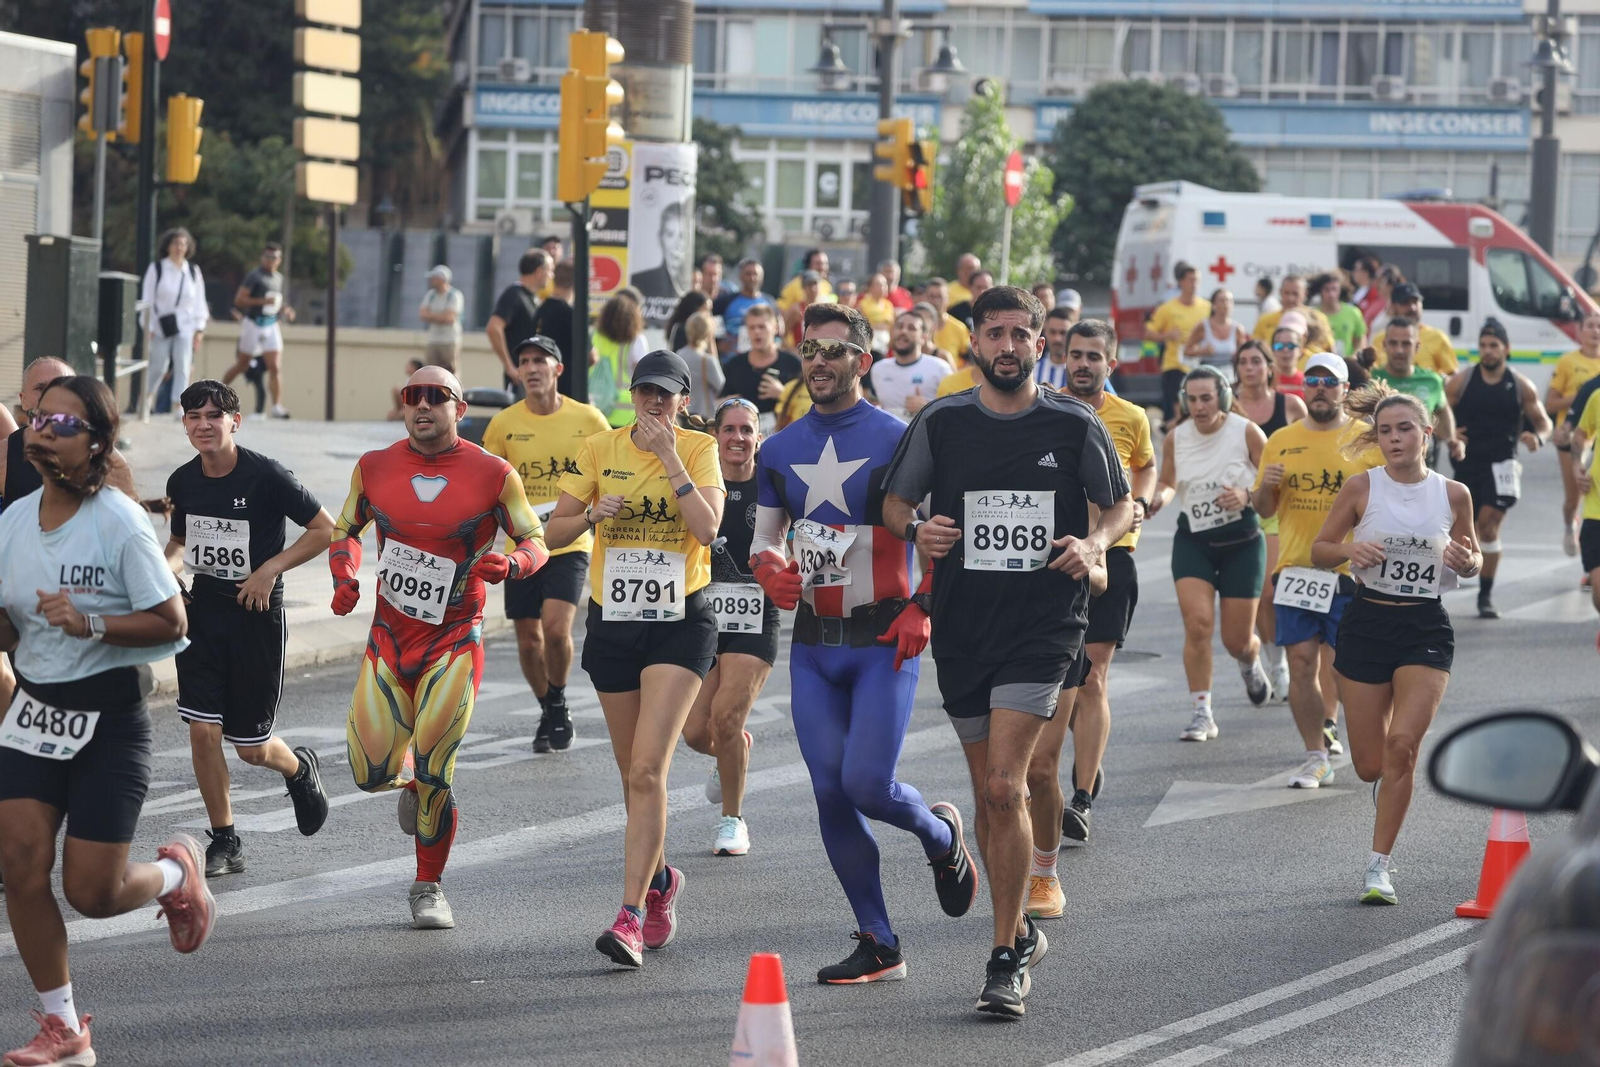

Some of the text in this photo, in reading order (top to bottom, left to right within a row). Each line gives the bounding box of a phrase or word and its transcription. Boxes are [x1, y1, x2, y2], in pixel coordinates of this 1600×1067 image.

[1370, 111, 1524, 134] INGECONSER
[1038, 460, 1058, 468] adidas
[1289, 473, 1315, 491] 45
[977, 496, 1005, 507] 45
[1192, 498, 1224, 519] 623
[193, 519, 213, 530] 45
[602, 532, 640, 541] URBANA
[974, 524, 1047, 552] 8968
[1384, 537, 1405, 546] 45
[191, 544, 245, 567] 1586
[391, 547, 413, 560] 45
[617, 552, 641, 563] 45
[60, 564, 105, 587] LCRC
[1380, 558, 1435, 584] 1384
[380, 568, 445, 604] 10981
[611, 578, 675, 603] 8791
[1284, 576, 1330, 599] 7265
[710, 597, 761, 615] 0893
[17, 700, 88, 740] 6480
